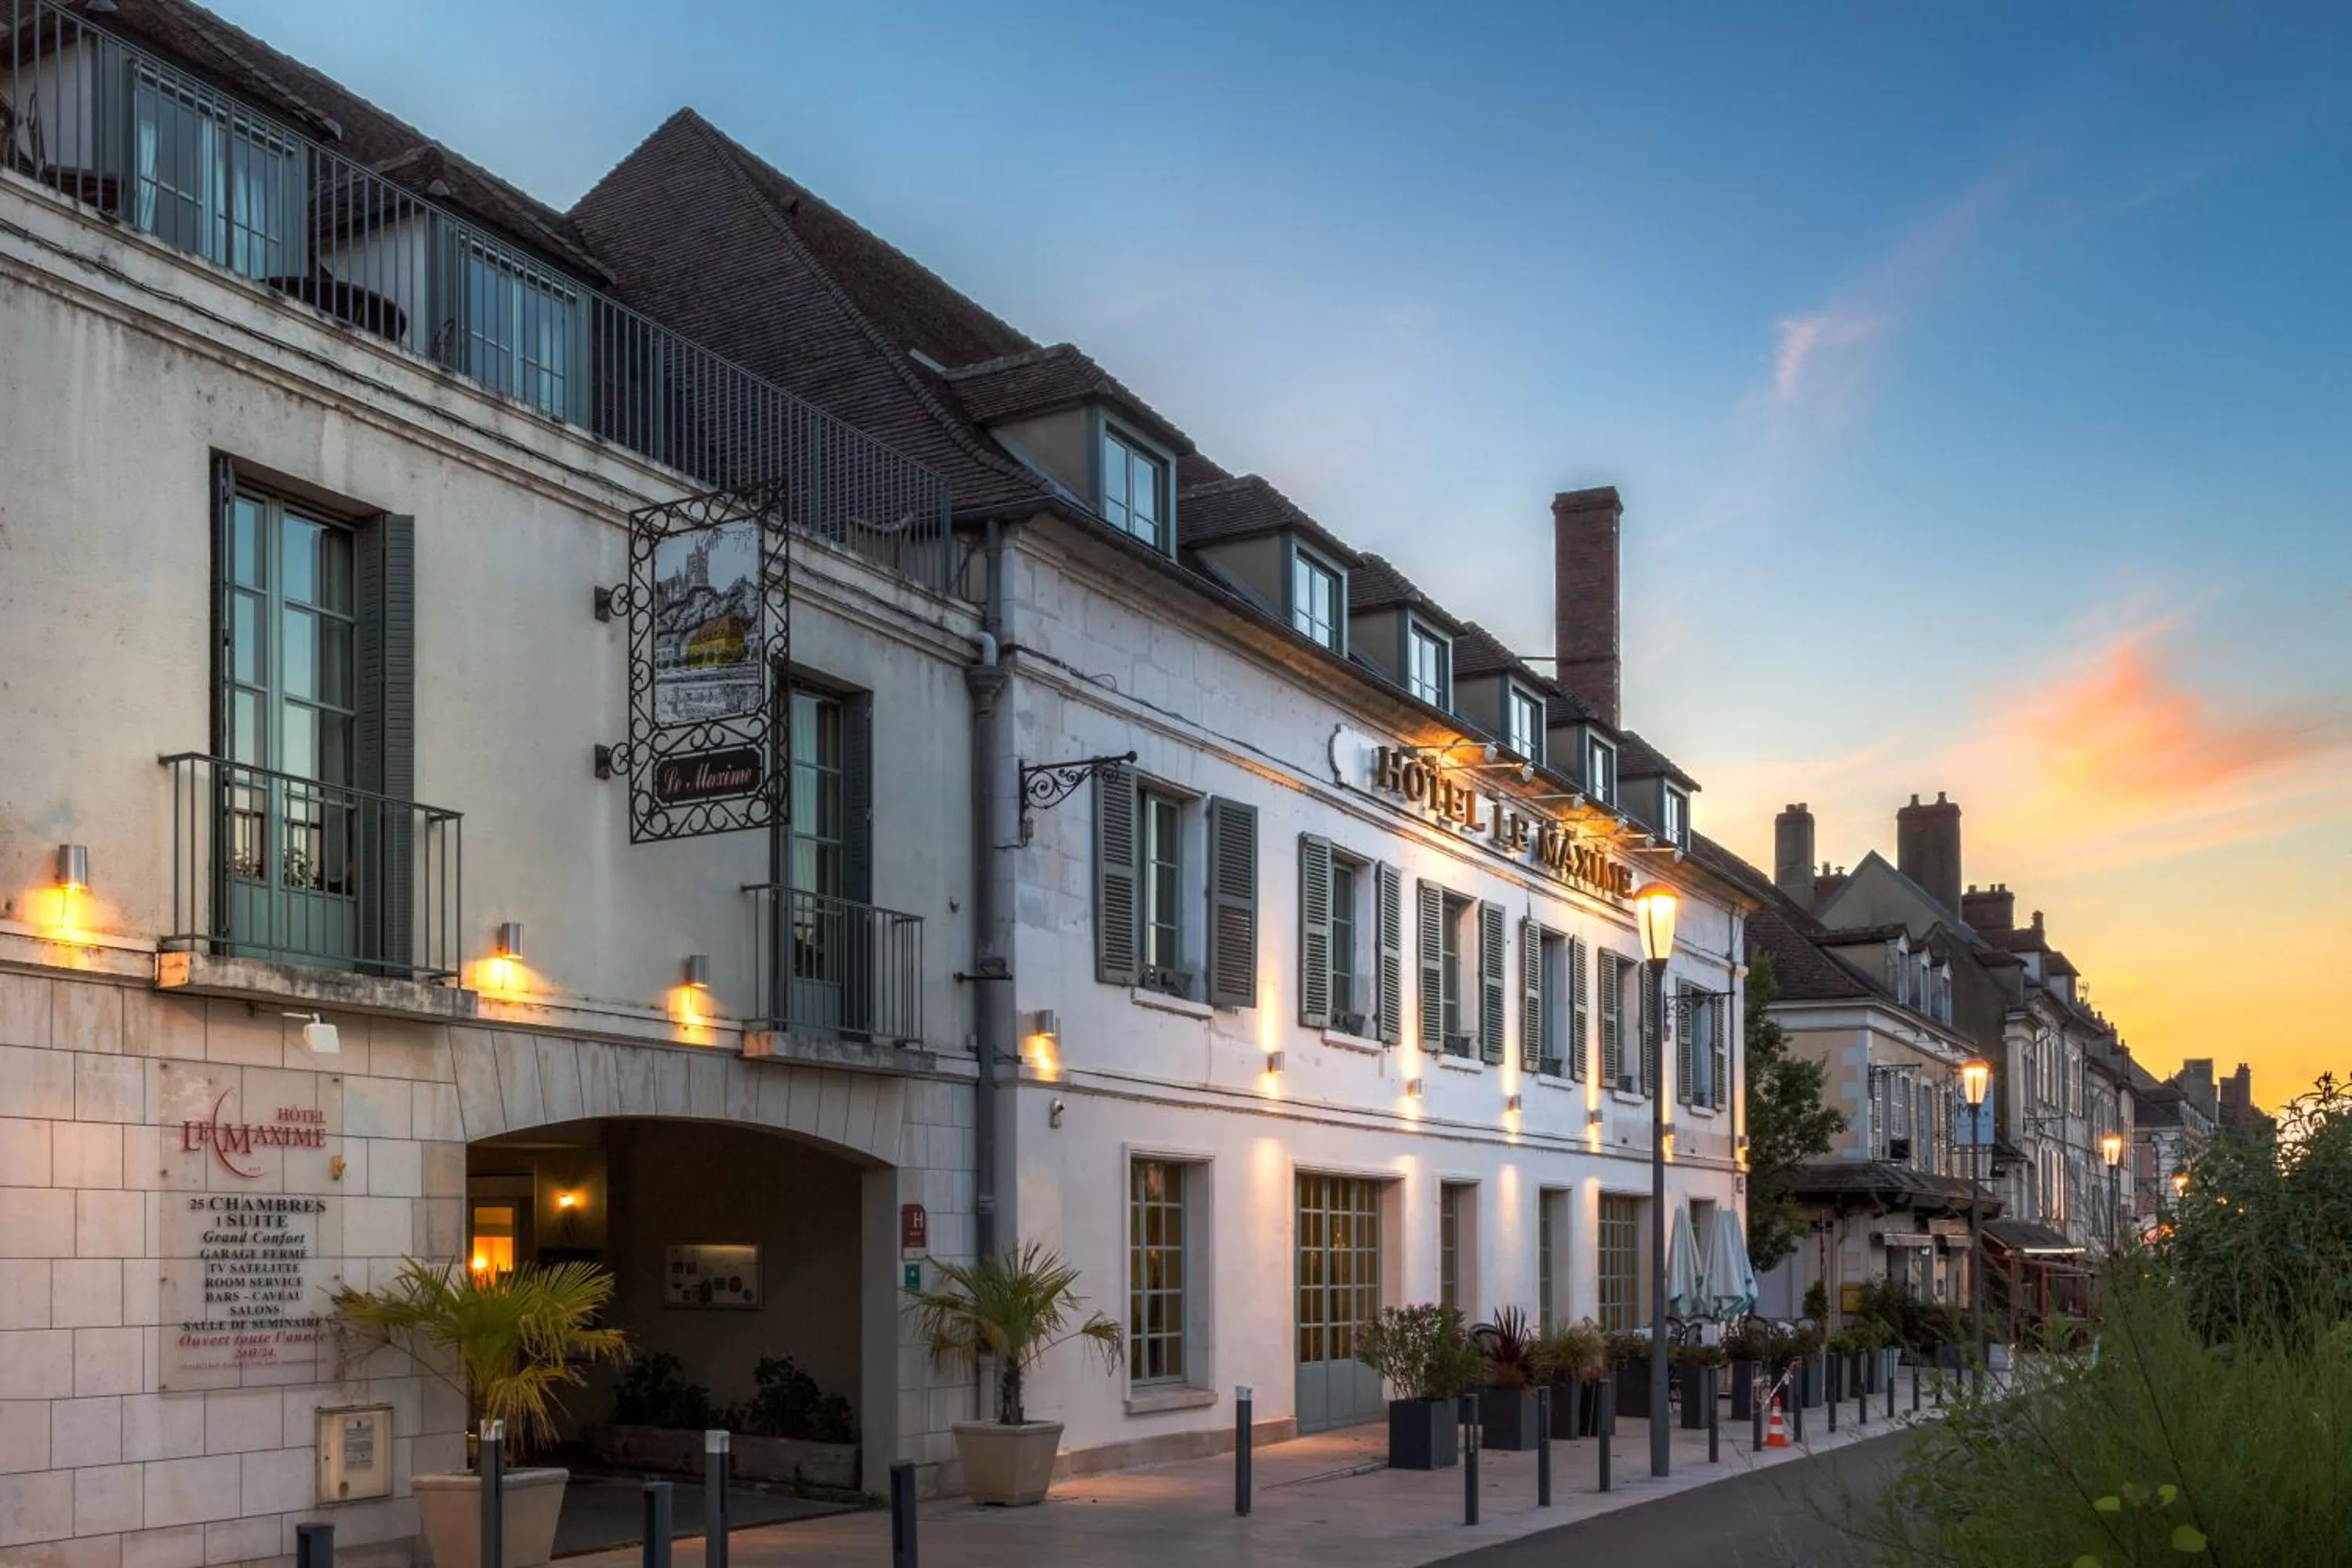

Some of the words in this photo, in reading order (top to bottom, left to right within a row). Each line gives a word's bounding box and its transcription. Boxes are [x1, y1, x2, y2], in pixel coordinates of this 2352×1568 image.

[663, 765, 683, 794] Le
[686, 762, 753, 791] Maxime
[1493, 803, 1529, 854] LE
[1537, 825, 1634, 899] MAXIME
[182, 1120, 209, 1152] LE
[223, 1123, 326, 1154] MAXIME
[190, 1198, 205, 1210] 25
[209, 1197, 326, 1213] CHAMBRES
[227, 1214, 289, 1228] SUITE
[913, 1211, 924, 1229] H
[202, 1230, 248, 1243] Grand
[252, 1230, 306, 1247] Confort
[200, 1248, 257, 1260] GARAGE
[209, 1263, 227, 1274] TV
[205, 1277, 245, 1288] ROOM
[249, 1276, 303, 1287] SERVICE
[205, 1291, 240, 1302] BARS
[252, 1290, 303, 1301] CAVEAU
[230, 1305, 280, 1316] SALONS
[183, 1320, 227, 1331] SALLE
[231, 1319, 247, 1330] DE
[179, 1333, 230, 1348] Ouvert
[234, 1331, 271, 1345] toute
